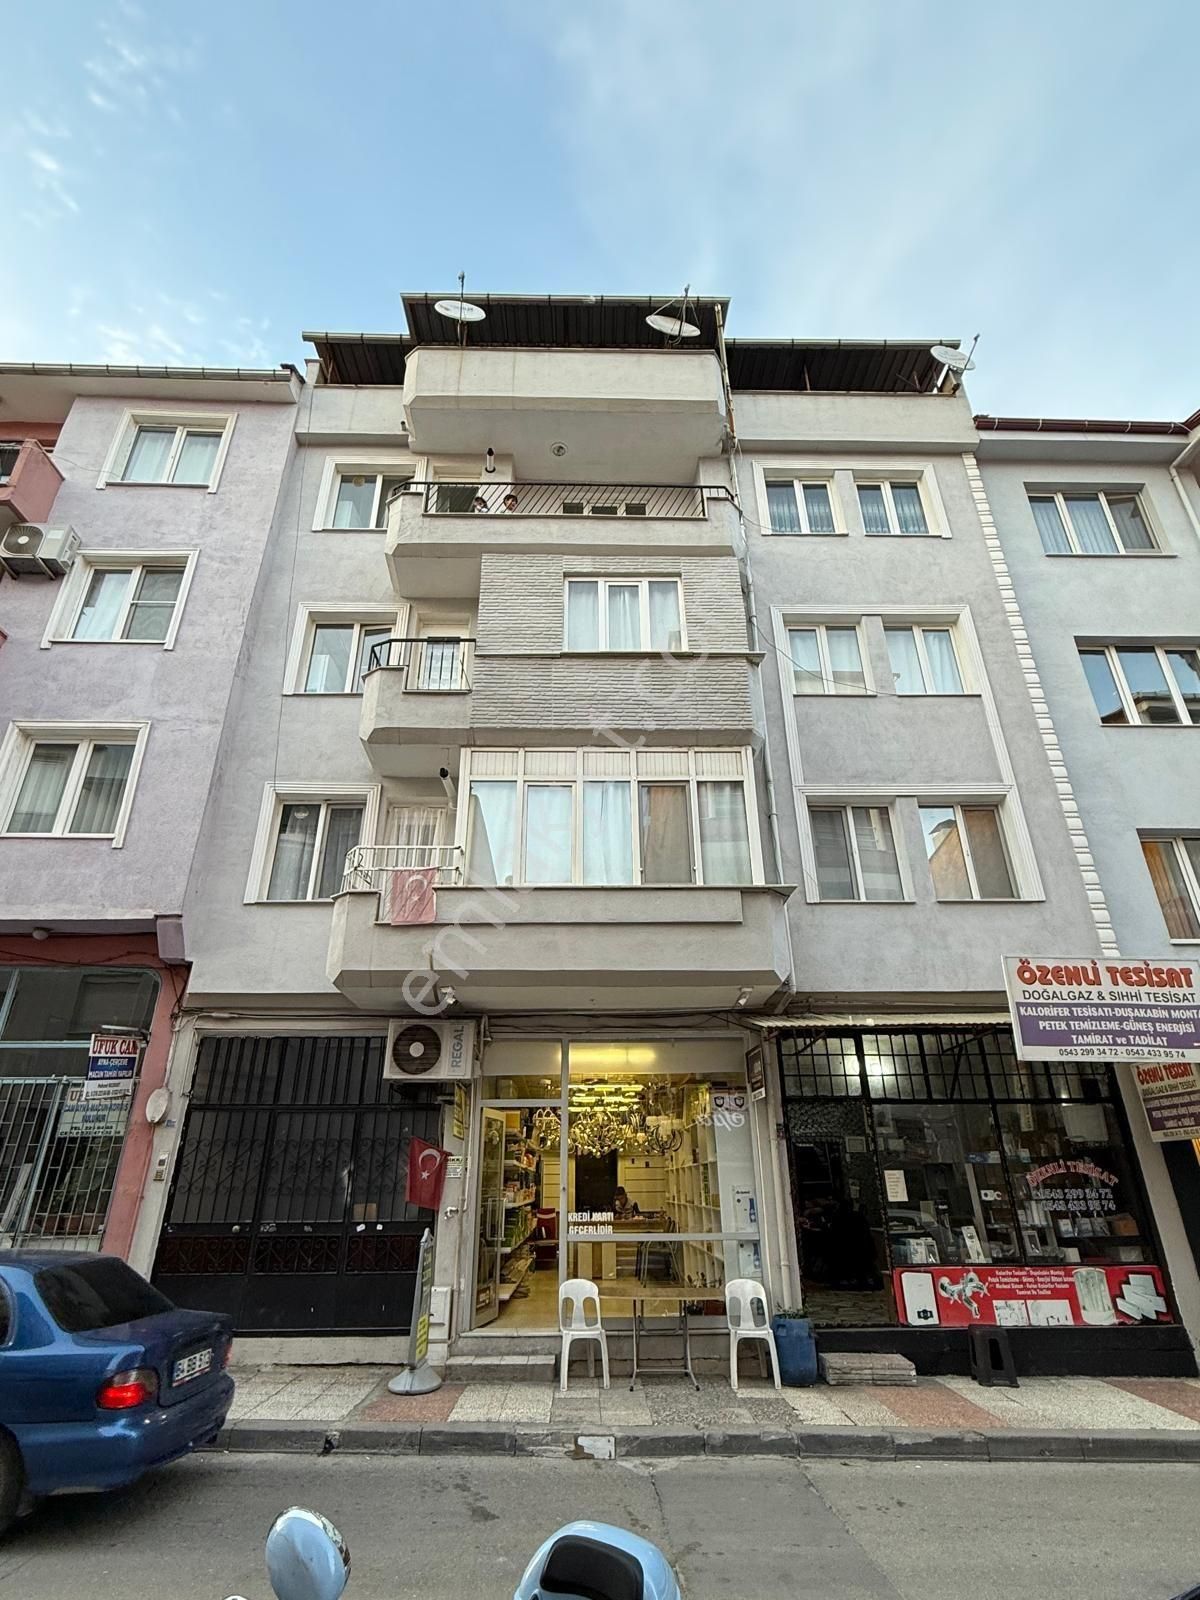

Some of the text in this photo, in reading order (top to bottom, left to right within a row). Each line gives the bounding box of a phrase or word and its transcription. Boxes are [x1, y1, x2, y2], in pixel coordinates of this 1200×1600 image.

[1016, 958, 1194, 988] ÖZENLİ TESİSAT
[1022, 988, 1196, 1003] DOĞALGAZ & SIHHİ TESİSAT
[1019, 1005, 1071, 1017] KALORİFER
[1072, 1004, 1169, 1020] TESİSATI-DUŞAKABİN
[1039, 1018, 1195, 1035] PETEK TEMİZLEME-GÜNEŞ ENERJİSİ
[92, 1039, 118, 1055] UFUK
[451, 1025, 465, 1068] REGAL
[1071, 1032, 1168, 1046] TAMİRAT ve TADİLAT
[1059, 1048, 1079, 1056] 0543
[1080, 1048, 1095, 1056] 299
[1097, 1048, 1106, 1056] 34
[1107, 1048, 1119, 1056] 72
[1126, 1049, 1146, 1057] 0543
[1147, 1049, 1162, 1057] 433
[1164, 1050, 1174, 1058] 95
[1175, 1050, 1186, 1059] 74
[568, 1210, 590, 1222] KREDİ
